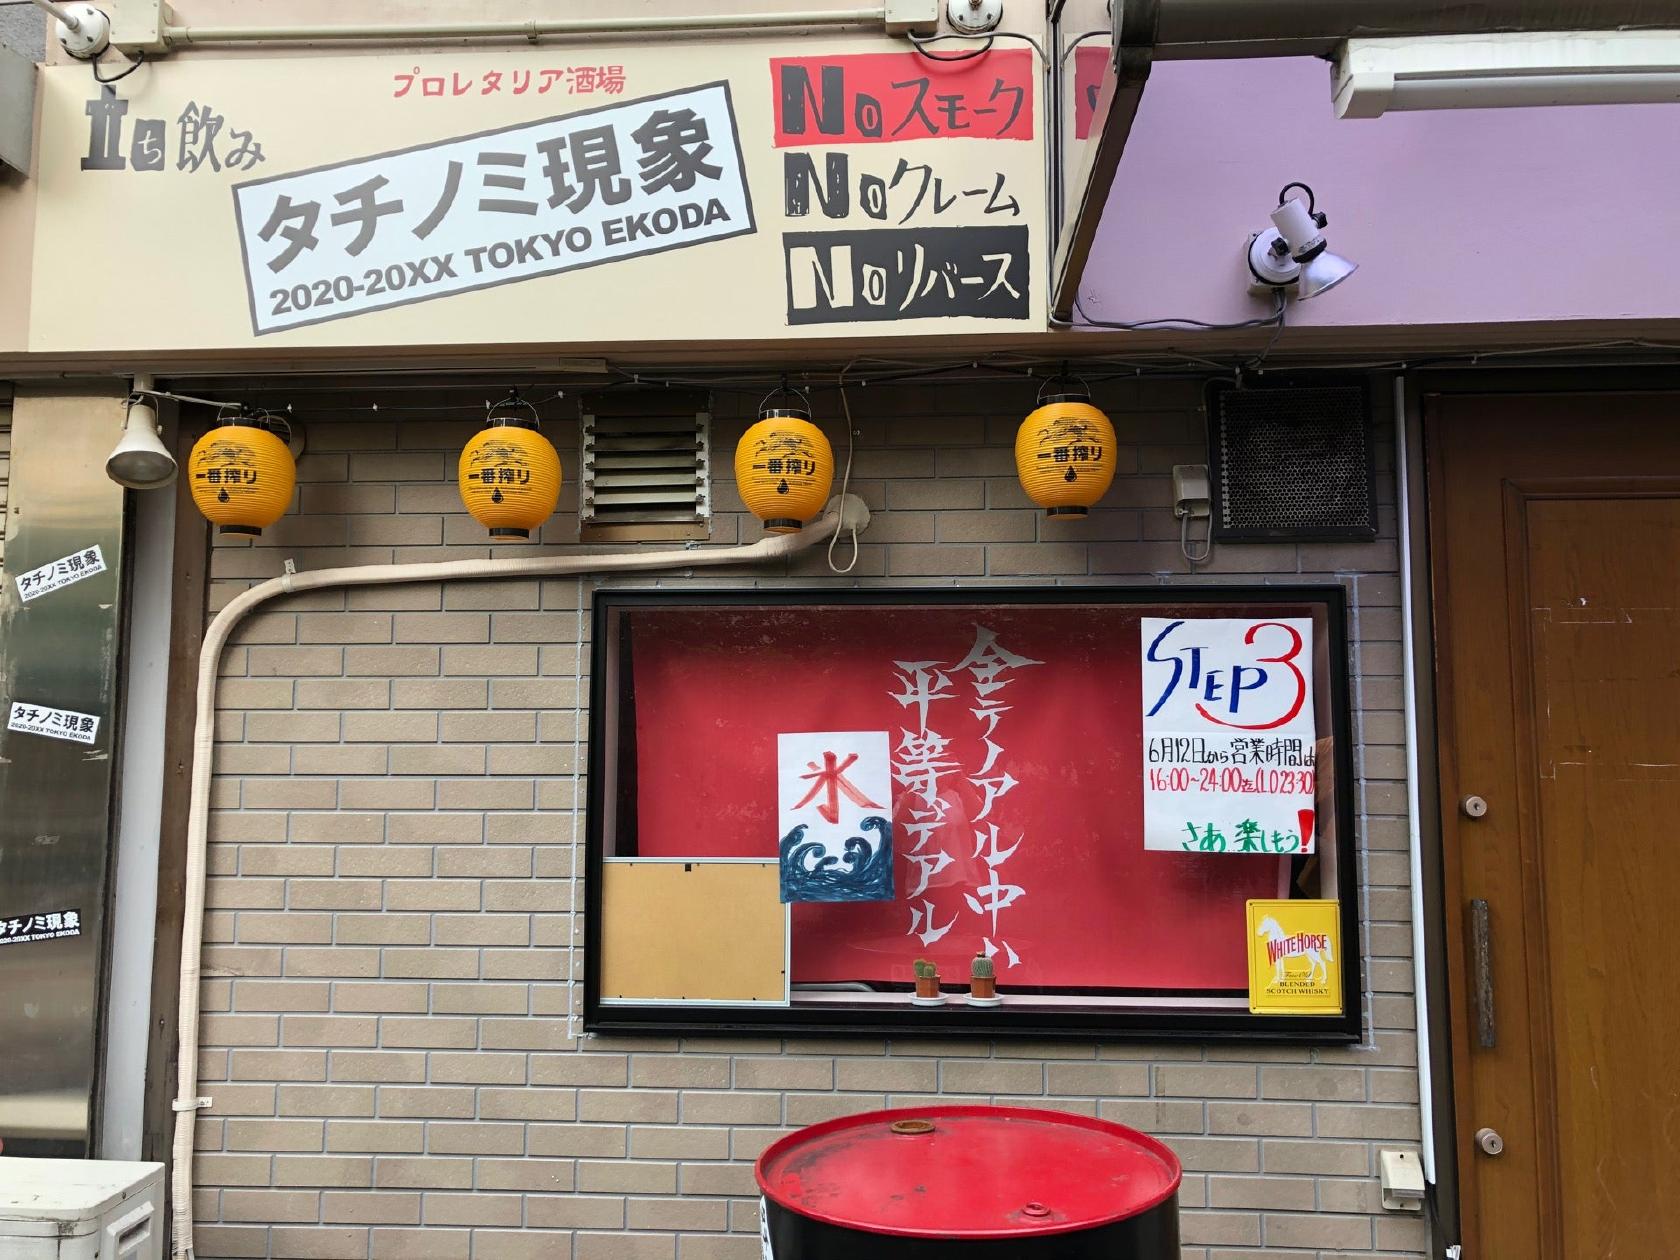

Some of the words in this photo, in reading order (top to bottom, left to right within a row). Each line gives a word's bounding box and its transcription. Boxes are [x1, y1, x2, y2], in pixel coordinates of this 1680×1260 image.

[393, 65, 626, 98] プロレタリア酒場
[81, 84, 266, 173] 立ち飲み
[257, 107, 723, 274] タチノミ現象
[269, 252, 458, 316] 2020-20XX
[465, 226, 593, 274] TOKYO
[602, 197, 731, 247] EKODA
[752, 458, 816, 476] 一番搾り
[1037, 446, 1103, 463] 一番搾り
[195, 468, 257, 484] 一番搾り
[468, 468, 530, 485] 一番搾り
[20, 549, 100, 592] タチノミ現象
[13, 705, 95, 733] タチノミ現象
[790, 751, 886, 824] 氷
[887, 660, 963, 947] 平等デアル
